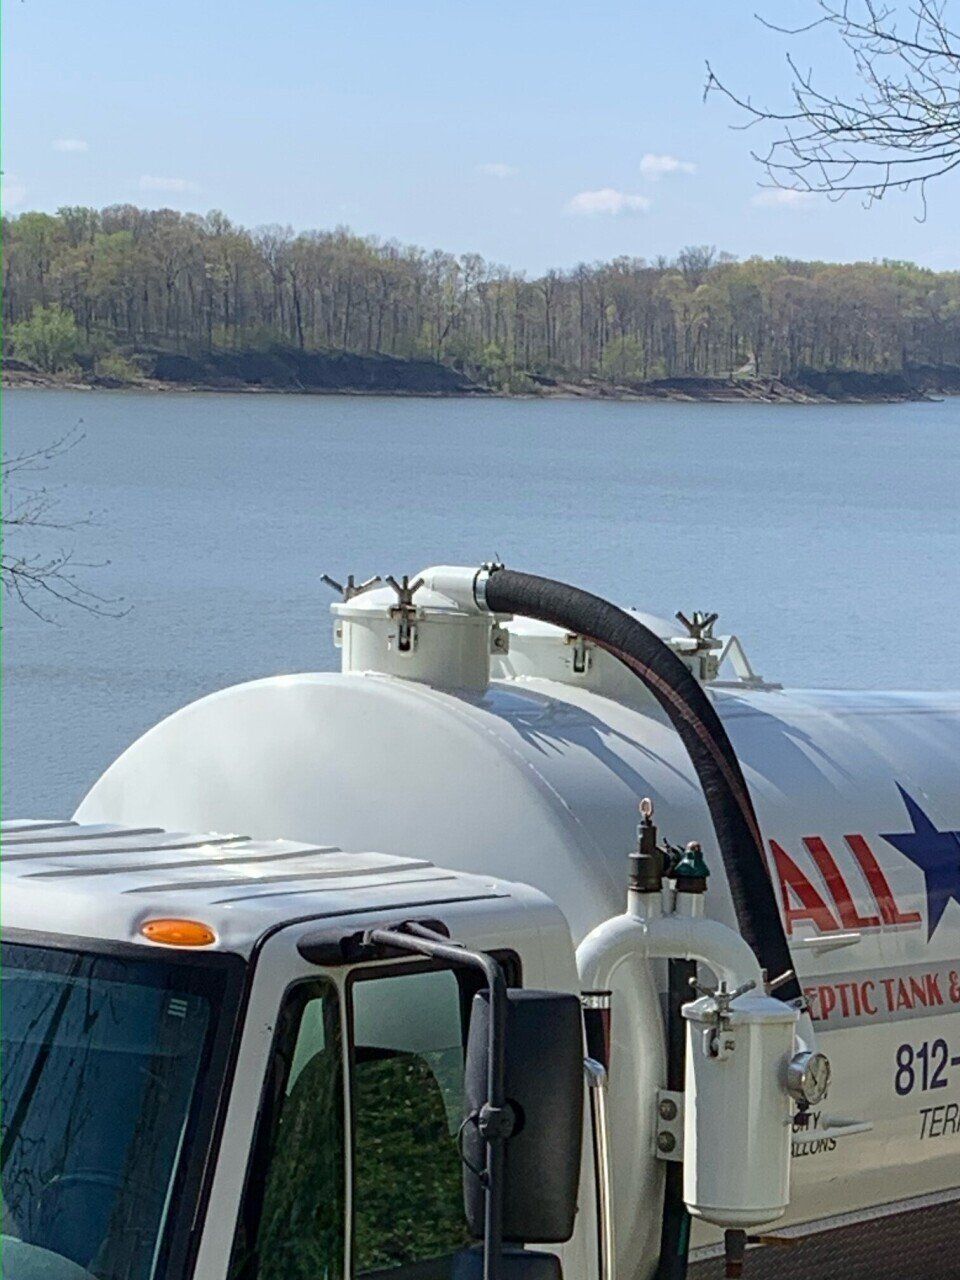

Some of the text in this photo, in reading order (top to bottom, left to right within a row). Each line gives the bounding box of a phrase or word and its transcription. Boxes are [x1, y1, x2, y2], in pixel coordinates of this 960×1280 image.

[769, 833, 922, 934] ALL
[802, 981, 878, 1020] EPTIC
[879, 973, 944, 1013] TANK
